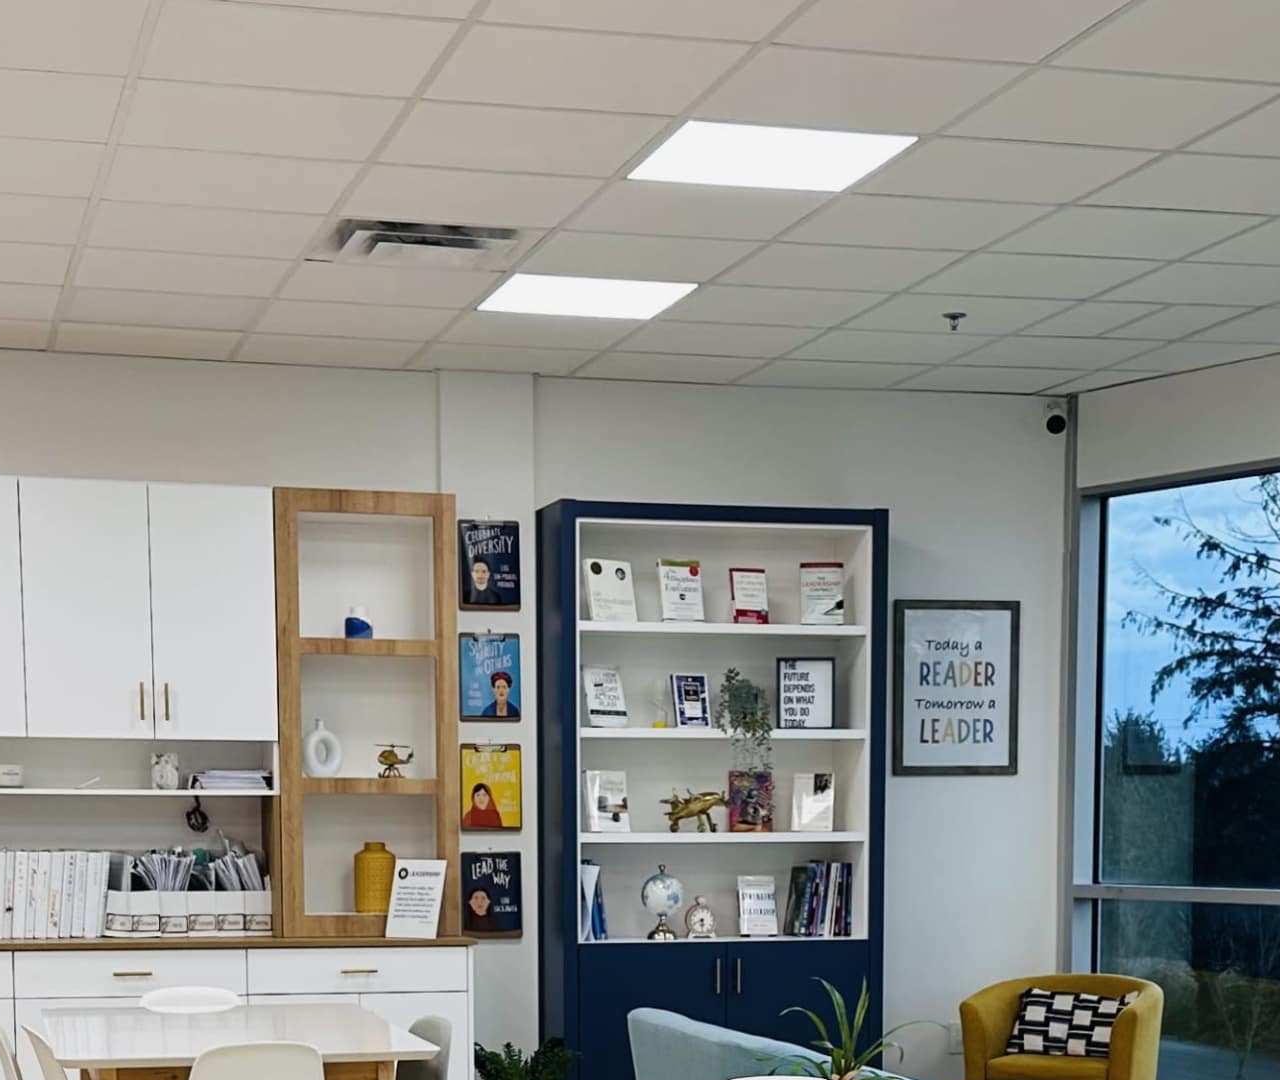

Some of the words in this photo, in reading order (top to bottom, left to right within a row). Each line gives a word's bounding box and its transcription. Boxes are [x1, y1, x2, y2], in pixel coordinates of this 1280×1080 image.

[465, 528, 500, 544] CELEBRATE
[468, 536, 513, 557] DIVERSITY
[925, 639, 970, 657] Today
[974, 640, 983, 651] a
[484, 655, 512, 674] OTHERS
[784, 660, 797, 670] THE
[784, 672, 810, 682] FUTURE
[919, 661, 996, 688] READER
[784, 684, 815, 693] DEPENDS
[784, 696, 794, 705] ON
[795, 696, 815, 705] WHAT
[914, 698, 984, 710] Tomorrow
[987, 699, 996, 709] a
[784, 707, 798, 717] YOU
[800, 707, 810, 717] DO
[784, 719, 806, 728] TODAY
[920, 718, 994, 745] LEADER
[471, 858, 494, 880] LEAD
[495, 858, 509, 871] THE
[492, 872, 511, 889] WAY
